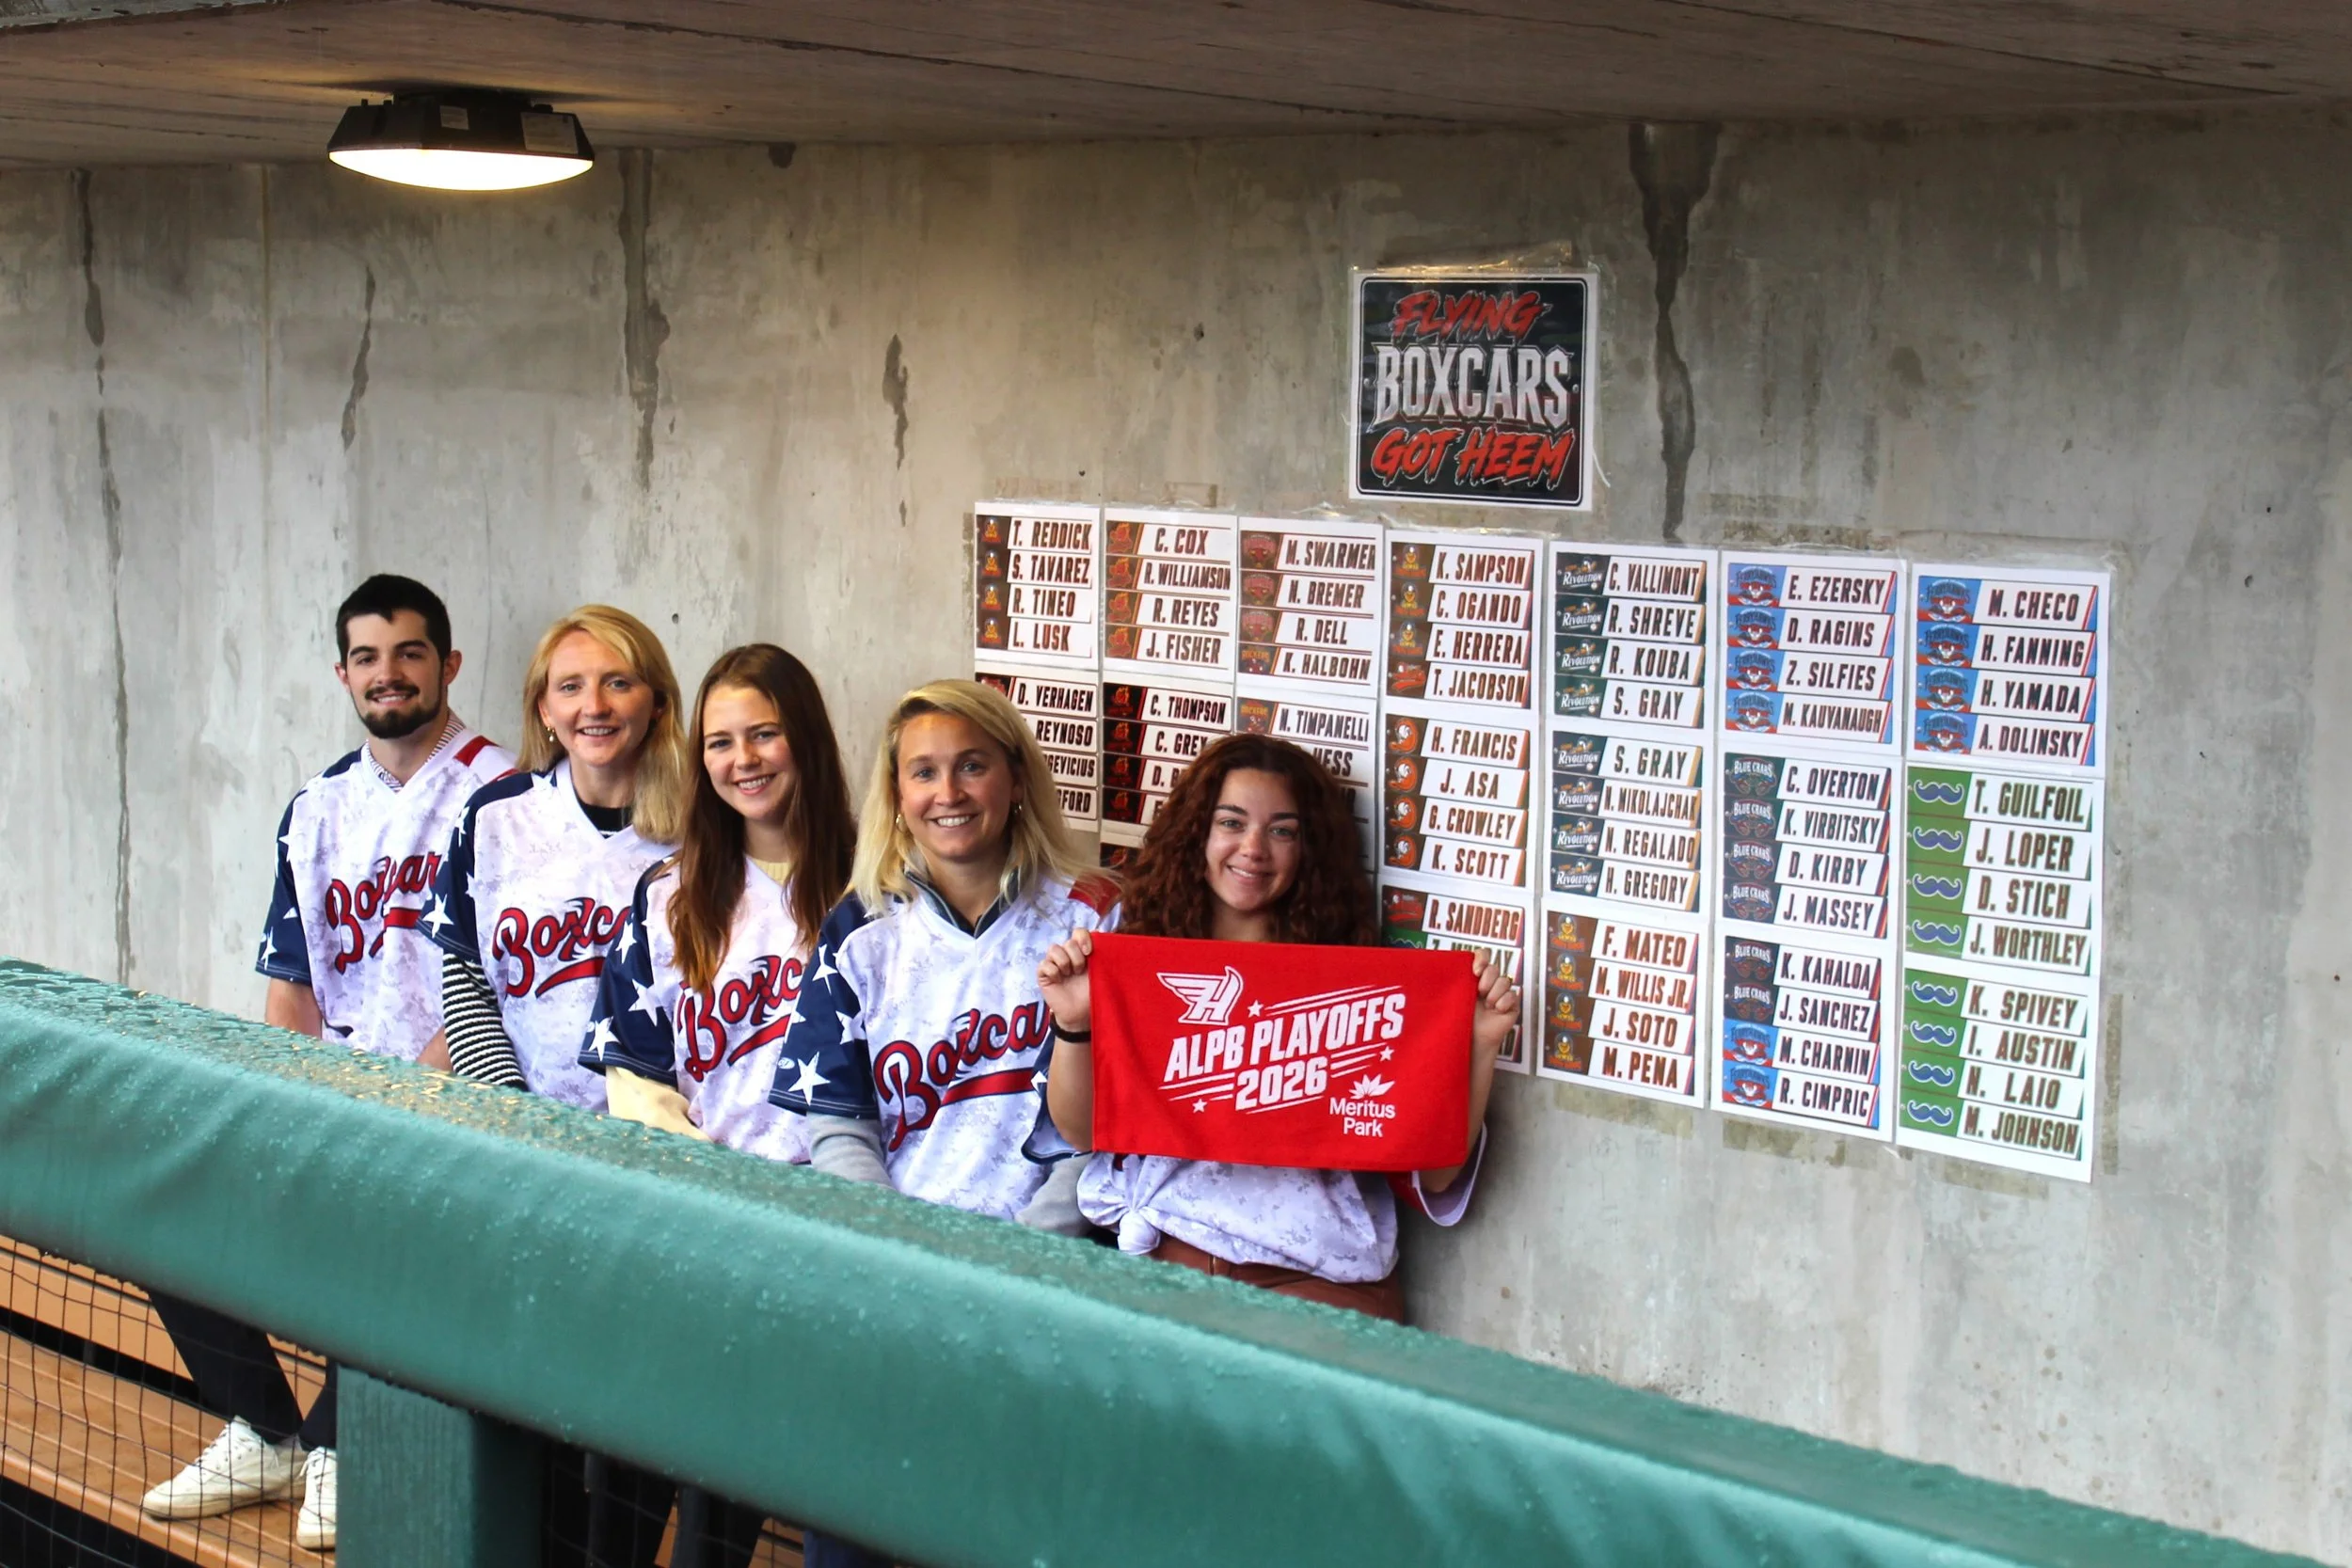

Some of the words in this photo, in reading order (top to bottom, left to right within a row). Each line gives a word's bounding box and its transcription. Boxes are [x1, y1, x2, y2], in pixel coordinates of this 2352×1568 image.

[1393, 290, 1552, 342] FLYING
[1368, 342, 1574, 431] BOXCARS
[1371, 428, 1465, 486] GOT
[1455, 427, 1575, 489] HEEM
[1013, 520, 1022, 546] T.
[1031, 521, 1092, 550] REDDICK
[1154, 528, 1168, 552] C.
[1174, 529, 1209, 555] COX
[1012, 554, 1023, 579] S.
[1031, 555, 1090, 583] TAVAREZ
[1286, 540, 1299, 564] M.
[1305, 541, 1375, 570] SWARMER
[1437, 552, 1449, 579] K.
[1455, 553, 1526, 584] SAMPSON
[1144, 562, 1154, 584] R.
[1158, 563, 1231, 590] WILLIAMSON
[1609, 562, 1620, 592] C.
[1628, 563, 1699, 595] VALLIMONT
[1788, 575, 1802, 600] E.
[1809, 576, 1885, 605] EZERSKY
[1013, 588, 1024, 613] R.
[1033, 589, 1076, 617] TINEO
[1288, 579, 1300, 603] N.
[1308, 581, 1364, 609] BREMER
[1437, 591, 1448, 618] C.
[1456, 592, 1521, 623] OGANDO
[1988, 589, 2007, 617] M.
[2013, 591, 2079, 621] CHECO
[1152, 598, 1166, 623] R.
[1171, 598, 1220, 627] REYES
[1609, 605, 1622, 633] R.
[1629, 607, 1695, 639] SHREVE
[1013, 622, 1024, 647] L.
[1033, 624, 1072, 651] LUSK
[1295, 618, 1308, 641] R.
[1314, 619, 1347, 644] DELL
[1434, 629, 1445, 657] E.
[1453, 630, 1522, 664] HERRERA
[1788, 617, 1802, 642] D.
[1809, 619, 1874, 648] RAGINS
[1146, 633, 1160, 657] J.
[1166, 634, 1221, 664] FISHER
[1610, 645, 1624, 674] R.
[1633, 647, 1690, 680] KOUBA
[1981, 634, 1996, 662] H.
[2004, 636, 2085, 667] FANNING
[1283, 652, 1295, 673] K.
[1302, 654, 1371, 680] HALBOHN
[1787, 660, 1800, 686] Z.
[1807, 661, 1876, 691] SILFIES
[1018, 683, 1028, 705] D.
[1036, 685, 1093, 712] VERHAGEN
[1434, 669, 1442, 695] T.
[1449, 671, 1525, 703] JACOBSON
[1980, 679, 1996, 706] H.
[2005, 681, 2080, 714] YAMADA
[1150, 694, 1161, 716] C.
[1168, 696, 1226, 724] THOMPSON
[1613, 687, 1628, 716] S.
[1639, 689, 1683, 721] GRAY
[1036, 721, 1093, 746] REYNOSO
[1155, 731, 1168, 752] C.
[1279, 708, 1290, 732] N.
[1296, 710, 1369, 742] TIMPANELLI
[1979, 723, 1993, 751] A.
[1999, 725, 2083, 758] DOLINSKY
[1431, 727, 1444, 752] H.
[1452, 729, 1518, 760] FRANCIS
[1152, 766, 1164, 786] D.
[1614, 745, 1629, 774] S.
[1637, 748, 1687, 779] GRAY
[1440, 768, 1454, 794] J.
[1464, 771, 1499, 800] ASA
[1604, 786, 1613, 811] N.
[1787, 766, 1800, 793] C.
[1807, 768, 1880, 801] OVERTON
[1975, 780, 1988, 814] T.
[1997, 782, 2084, 823] GUILFOIL
[1429, 805, 1440, 831] G.
[1447, 807, 1516, 840] CROWLEY
[1784, 808, 1797, 836] K.
[1804, 811, 1880, 845] VIRBITSKY
[1432, 845, 1445, 870] K.
[1454, 847, 1509, 879] SCOTT
[1605, 827, 1616, 853] N.
[1623, 830, 1695, 863] REGALADO
[1976, 828, 1994, 863] J.
[2004, 831, 2074, 872] LOPER
[1606, 867, 1616, 894] H.
[1624, 869, 1688, 904] GREGORY
[1788, 851, 1803, 879] D.
[1811, 854, 1867, 886] KIRBY
[1784, 894, 1797, 921] J.
[1804, 895, 1874, 930] MASSEY
[1978, 876, 1995, 911] D.
[2007, 879, 2071, 919] STICH
[1429, 899, 1440, 929] R.
[1446, 902, 1519, 941] SANDBERG
[1602, 926, 1616, 957] F.
[1625, 929, 1686, 967] MATEO
[1970, 924, 1984, 955] J.
[1994, 926, 2087, 967] WORTHLEY
[1596, 966, 1610, 995] M.
[1617, 970, 1665, 1005] WILLIS
[1668, 979, 1689, 1008] JR.
[1781, 952, 1795, 979] K.
[1802, 956, 1870, 990] KAHALOA
[1779, 994, 1792, 1021] J.
[1799, 997, 1870, 1033] SANCHEZ
[1969, 985, 1988, 1016] K.
[2000, 990, 2078, 1029] SPIVEY
[1164, 1025, 1246, 1082] ALPB
[1250, 993, 1406, 1065] PLAYOFFS
[1603, 1007, 1619, 1037] J.
[1627, 1011, 1677, 1048] SOTO
[1779, 1036, 1795, 1064] M.
[1801, 1039, 1870, 1076] CHARNIN
[1968, 1025, 1982, 1056] I.
[1995, 1030, 2077, 1070] AUSTIN
[1235, 1057, 1328, 1111] 2026
[1602, 1046, 1622, 1078] M.
[1629, 1052, 1677, 1088] PENA
[1780, 1077, 1793, 1105] R.
[1802, 1081, 1869, 1117] CIMPRIC
[1966, 1066, 1985, 1098] N.
[2004, 1071, 2061, 1109] LAIO
[1330, 1098, 1395, 1119] Meritus
[1343, 1119, 1383, 1137] Park
[1964, 1106, 1983, 1137] M.
[1992, 1112, 2078, 1154] JOHNSON
